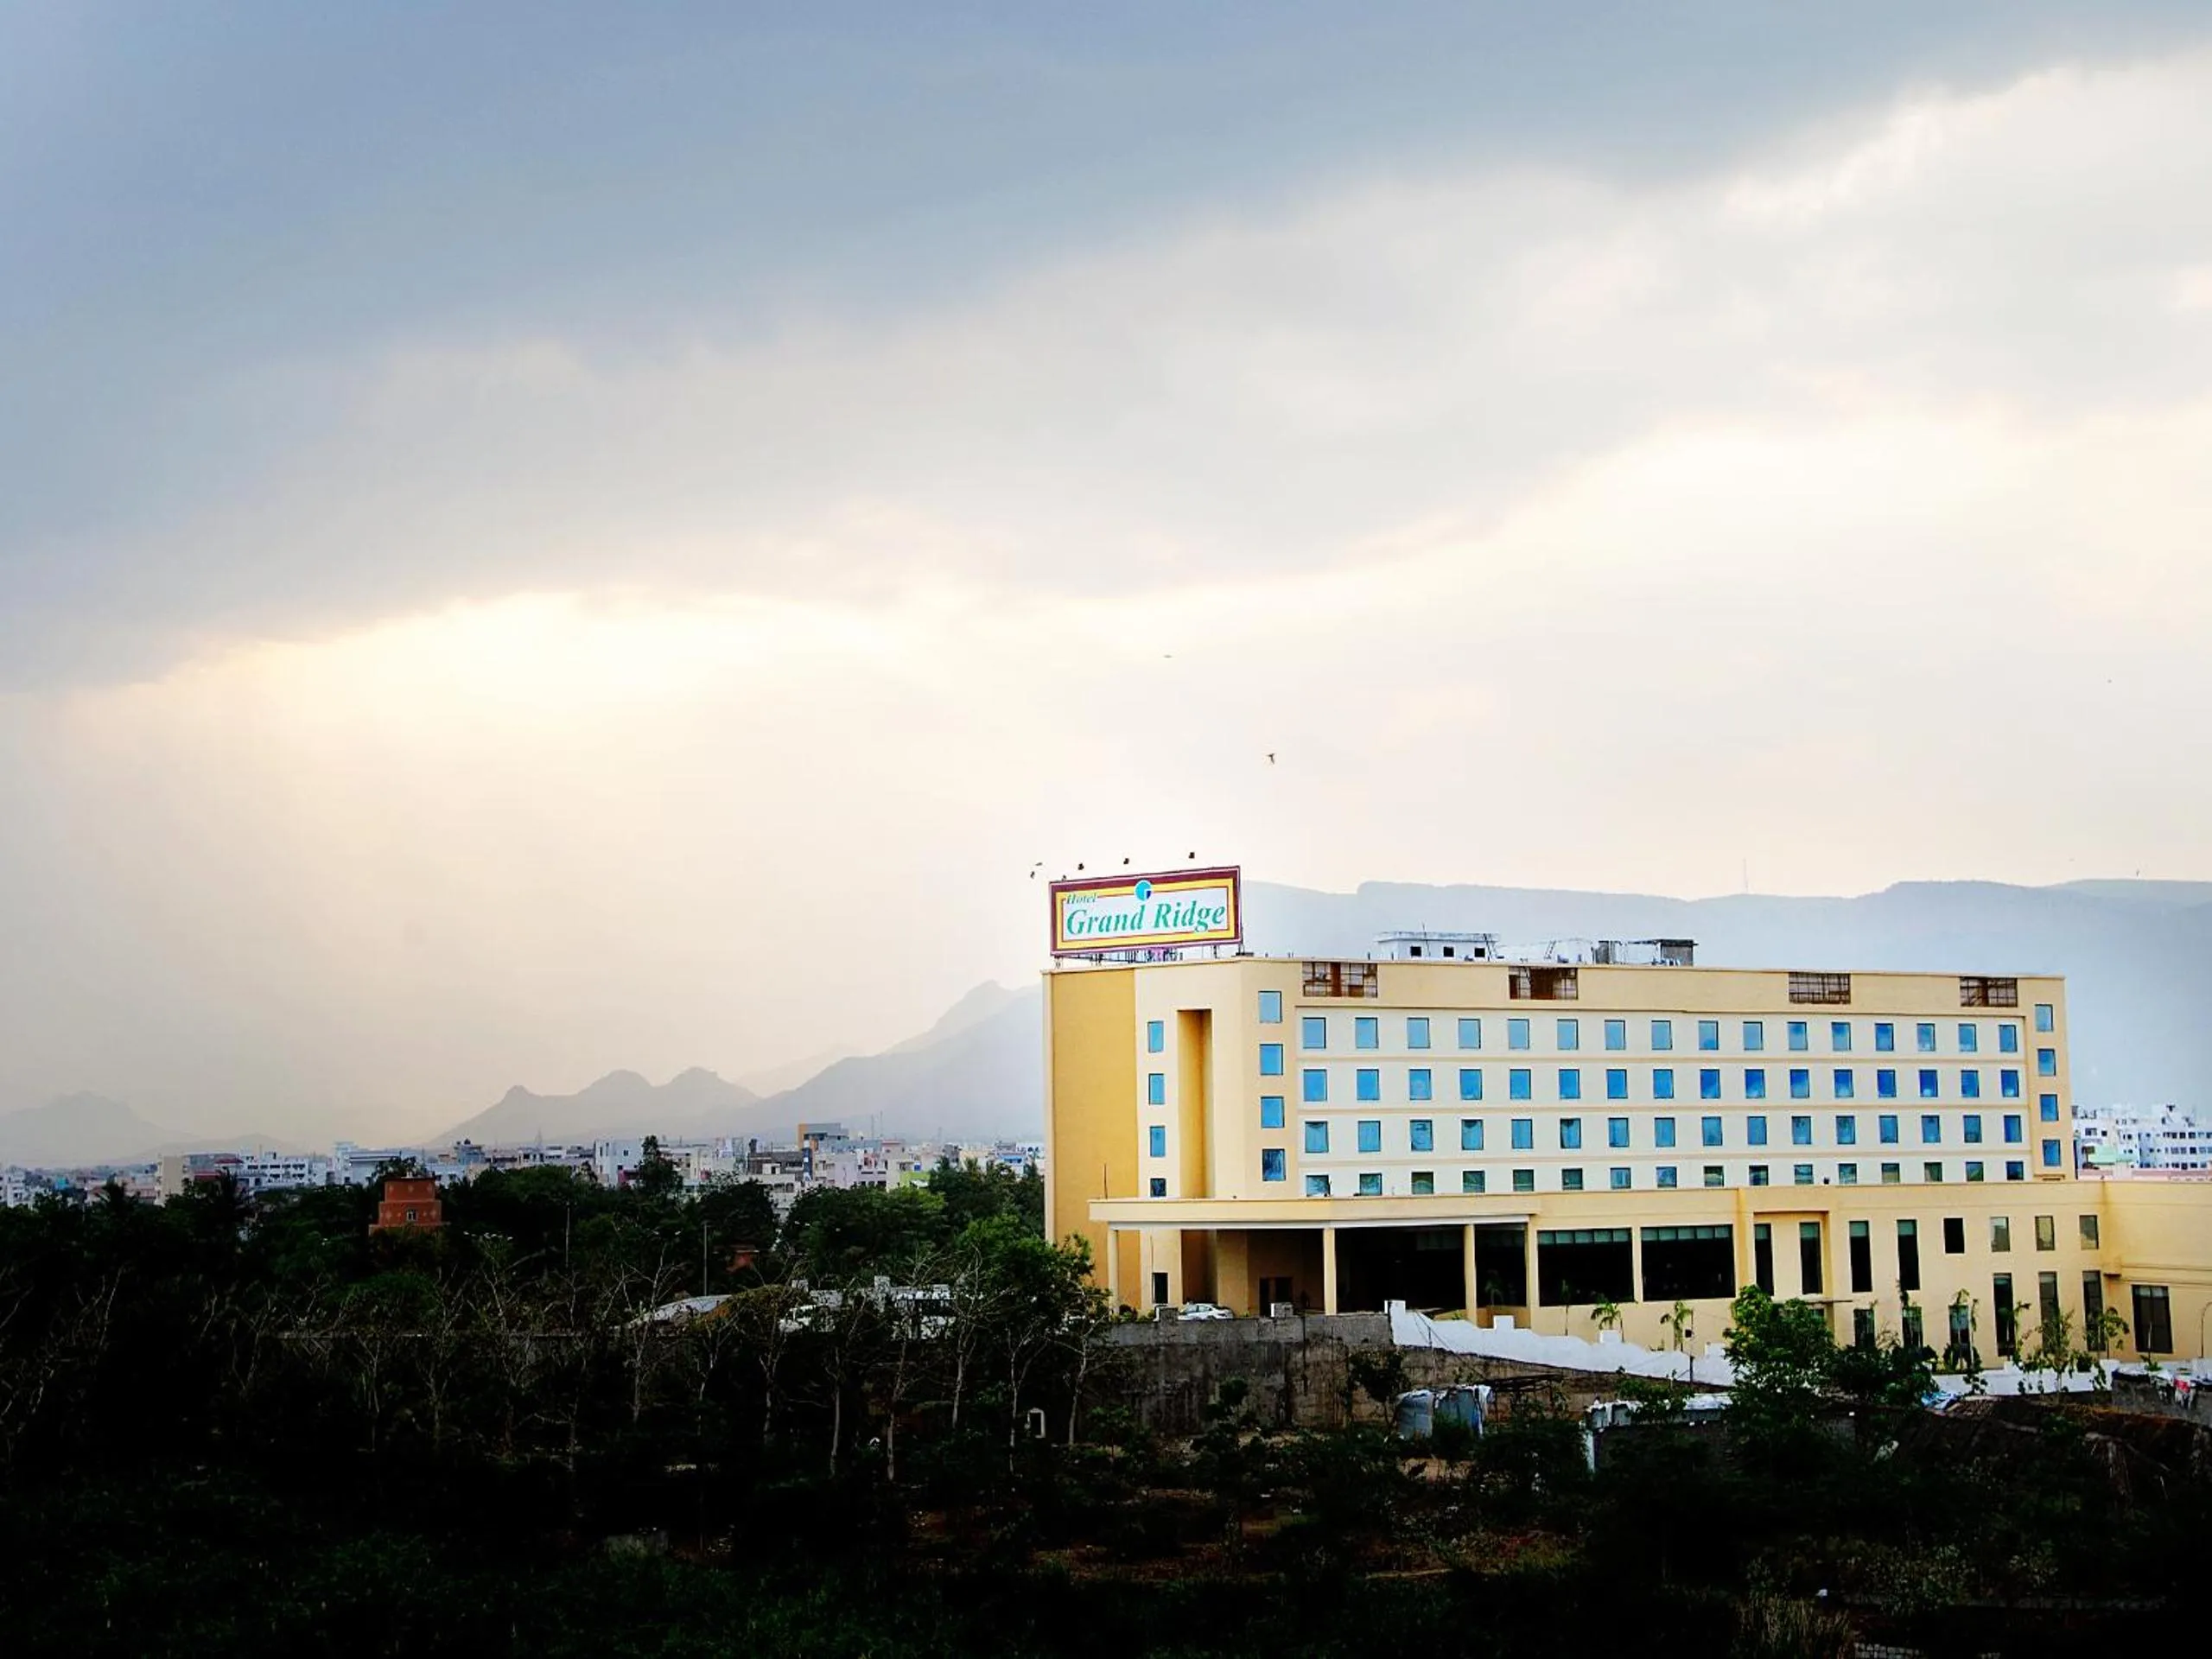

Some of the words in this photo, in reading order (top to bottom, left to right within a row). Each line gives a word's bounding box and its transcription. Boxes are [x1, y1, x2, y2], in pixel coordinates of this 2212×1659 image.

[1066, 892, 1097, 905] Hotel
[1066, 904, 1146, 935] Grand
[1154, 900, 1225, 932] Ridge
